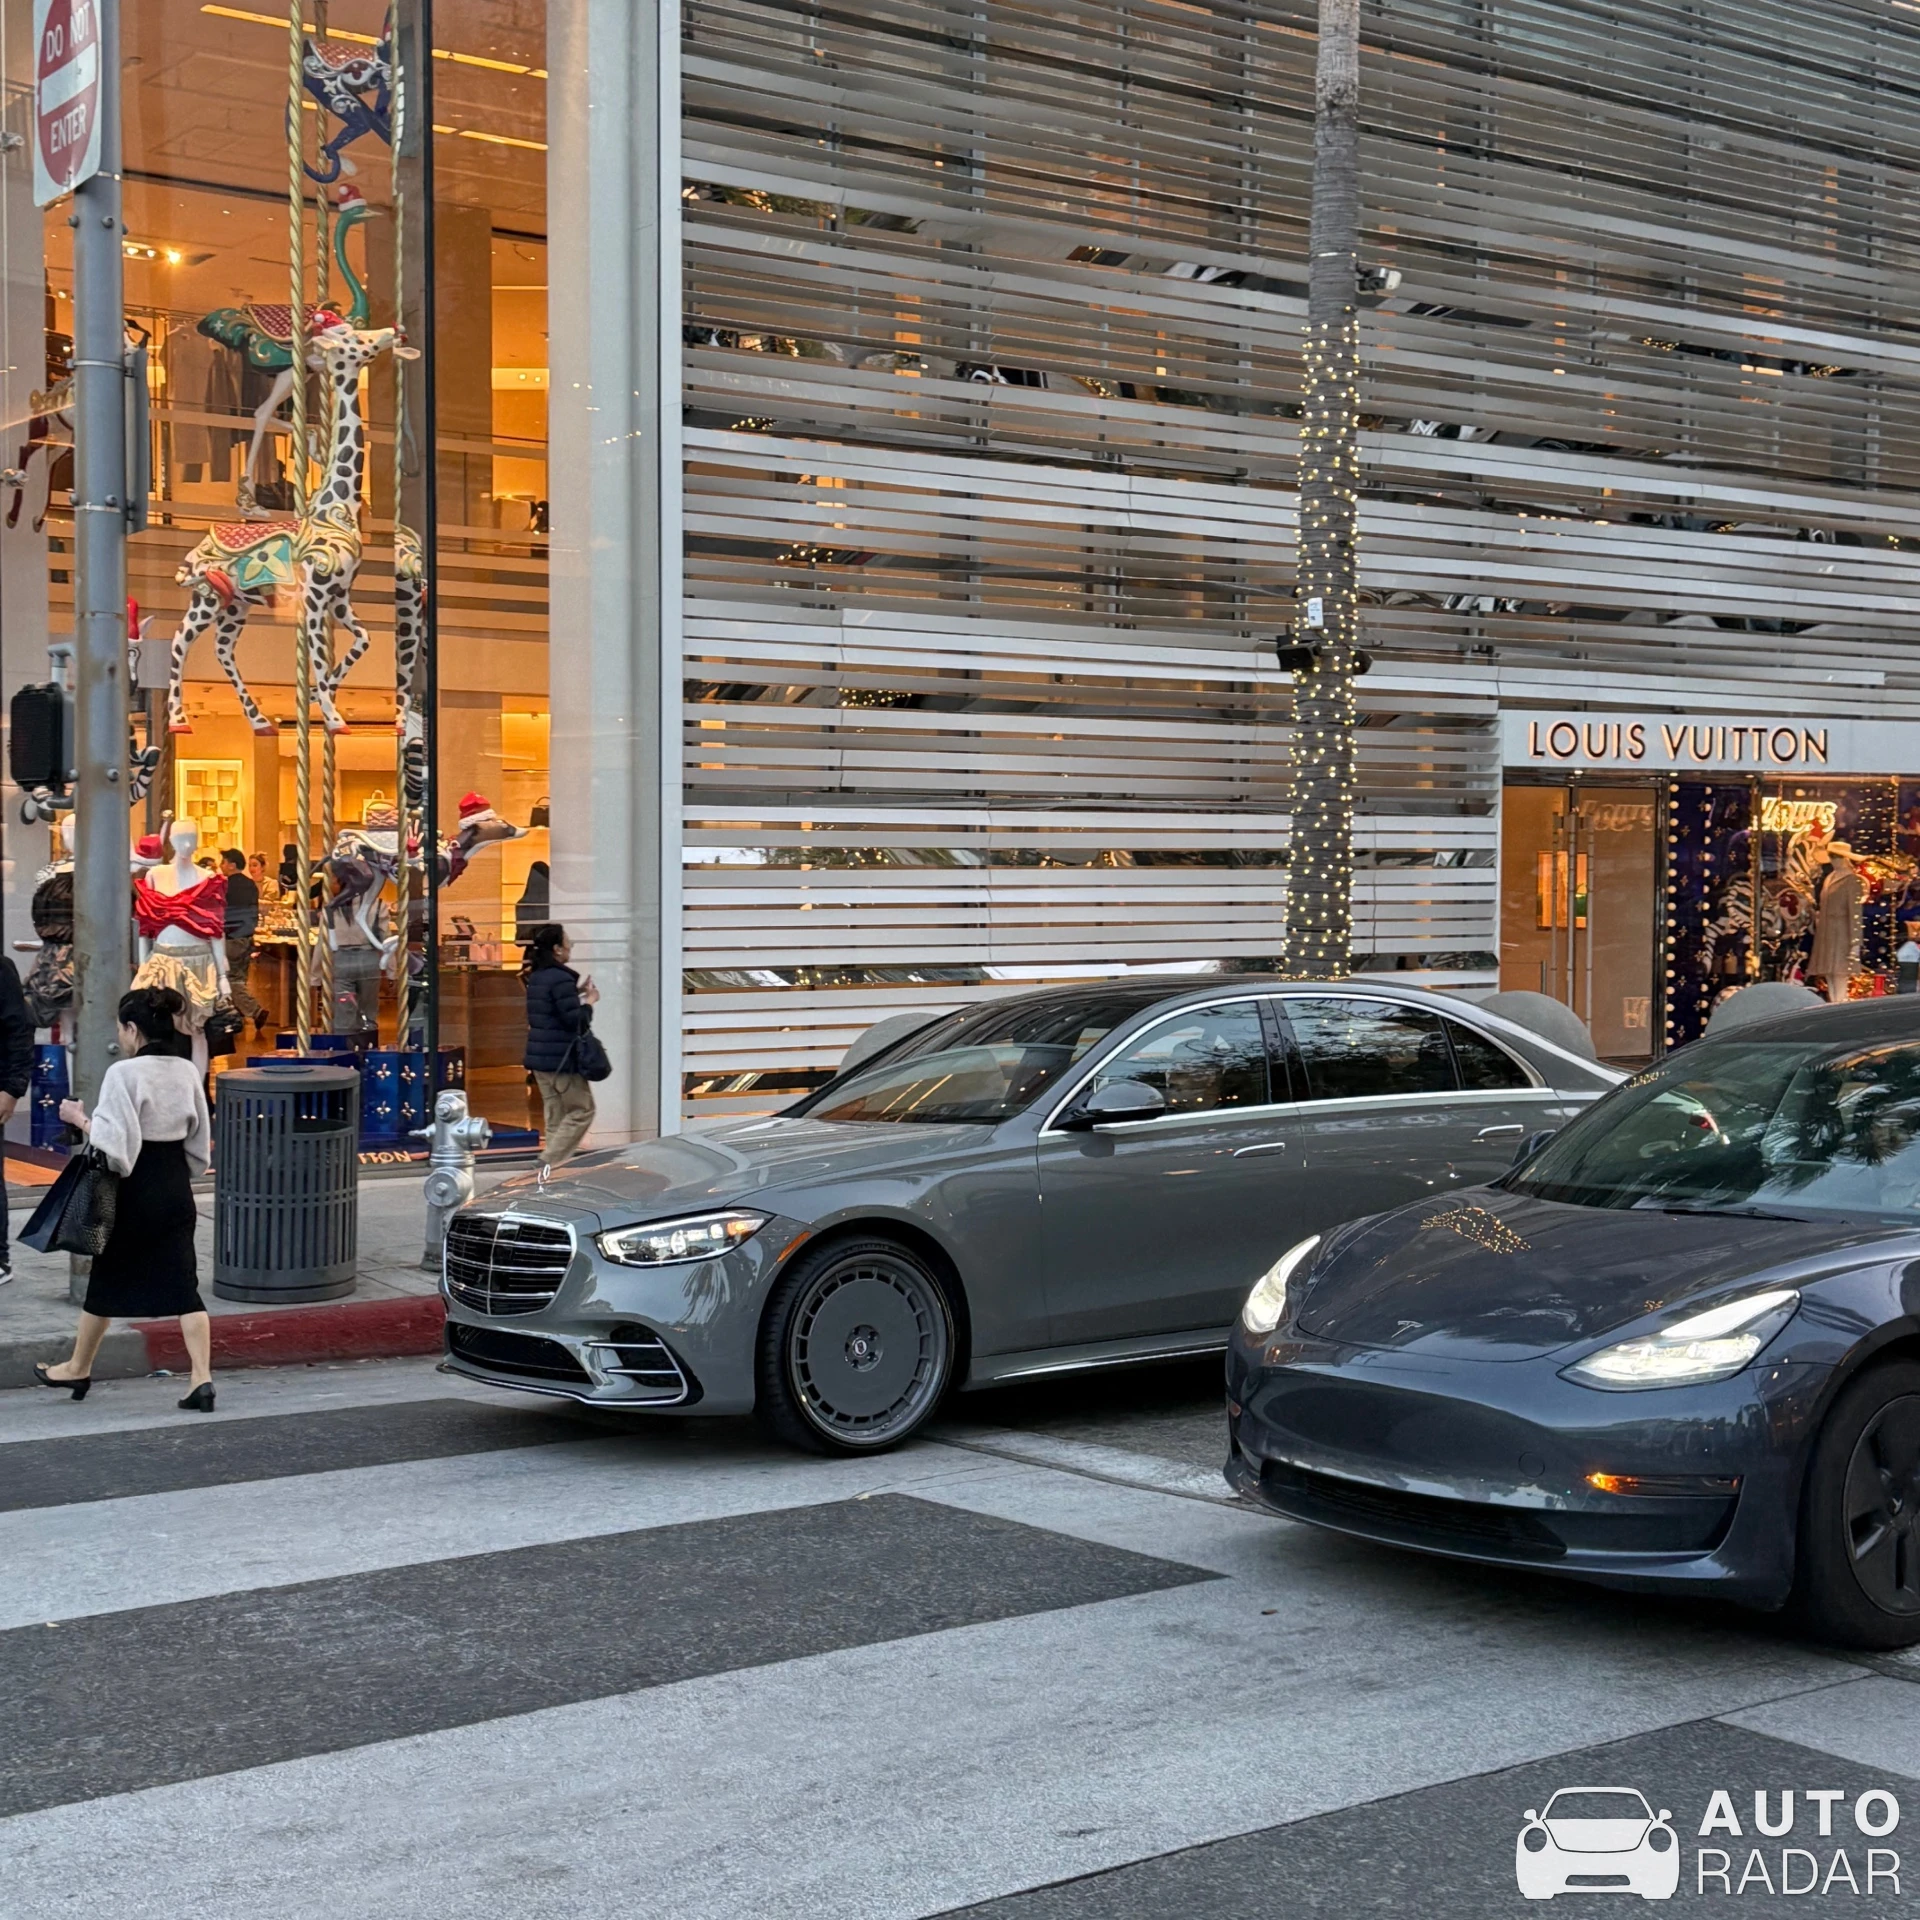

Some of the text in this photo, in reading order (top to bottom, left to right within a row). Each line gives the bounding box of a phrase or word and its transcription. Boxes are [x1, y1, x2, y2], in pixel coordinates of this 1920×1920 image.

[46, 1, 90, 63] DO NOT
[51, 103, 87, 154] ENTER
[1528, 720, 1828, 764] LOUIS VUITTON
